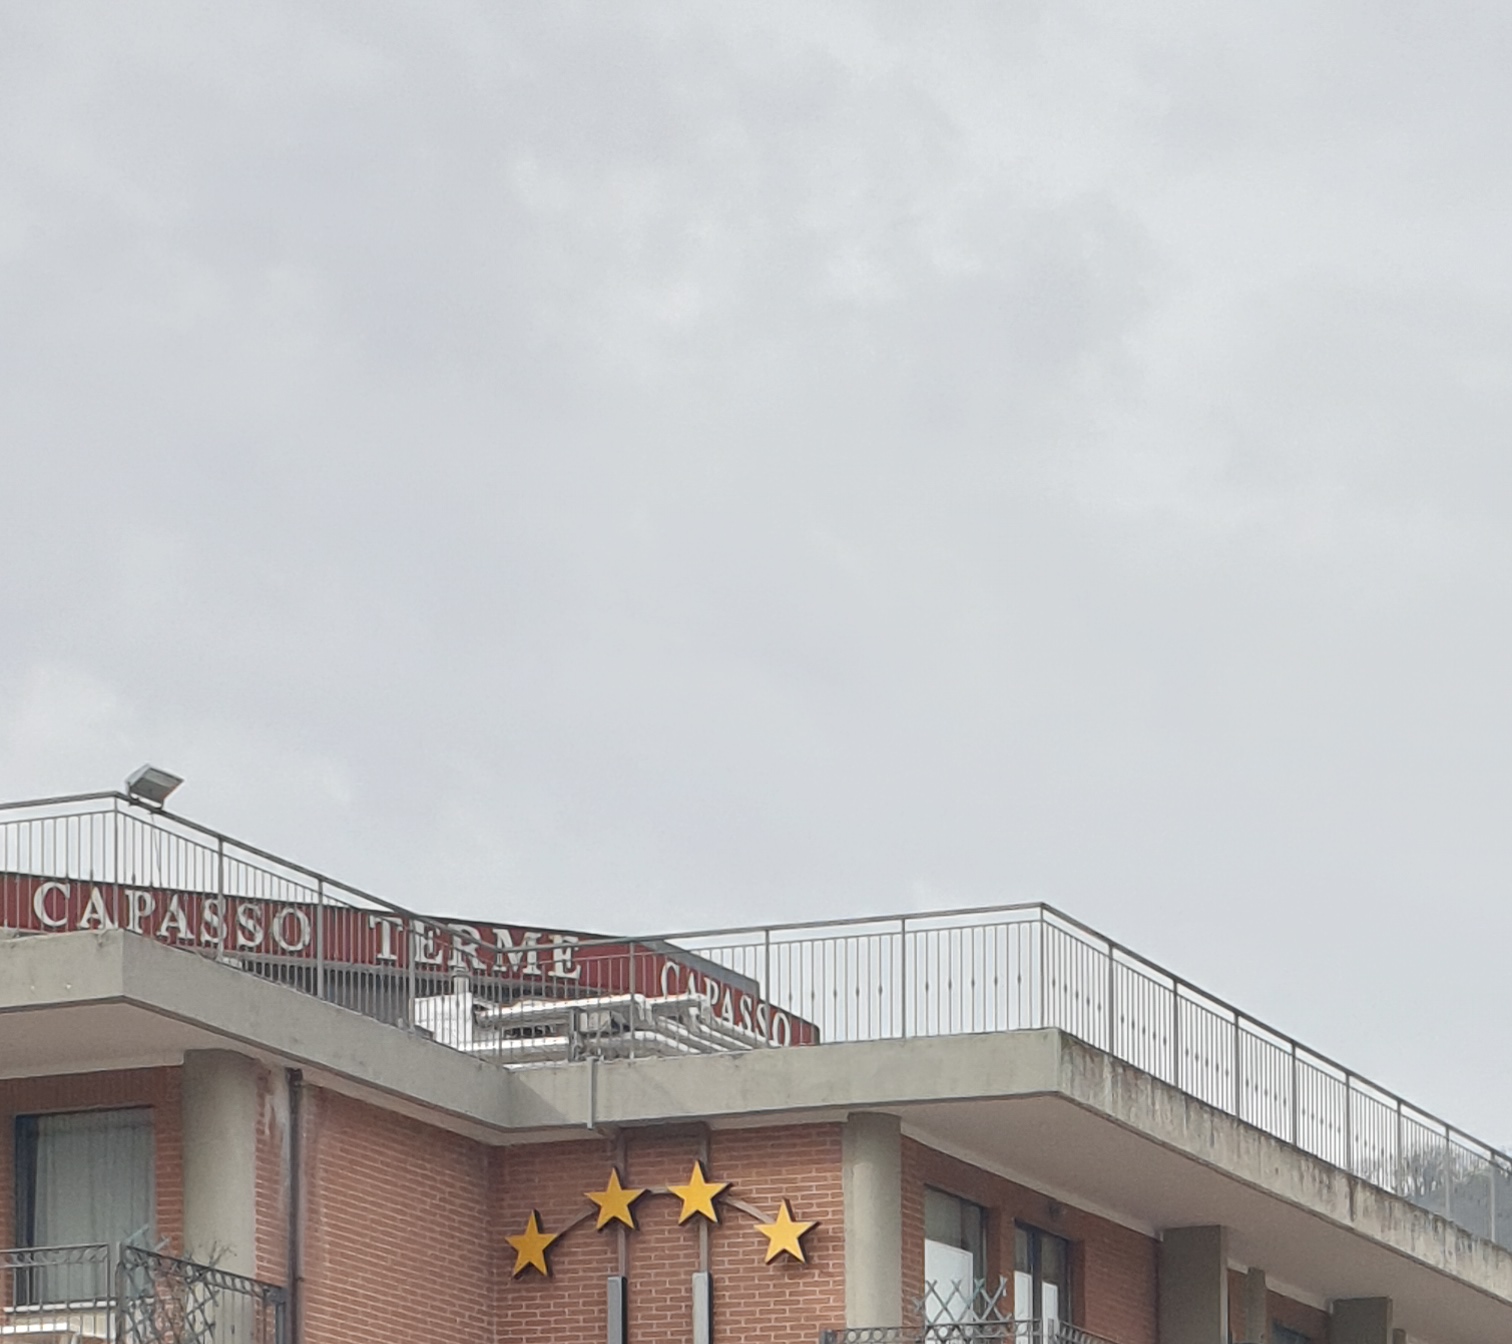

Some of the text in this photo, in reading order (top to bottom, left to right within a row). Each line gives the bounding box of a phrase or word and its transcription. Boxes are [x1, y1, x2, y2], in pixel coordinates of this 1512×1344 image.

[33, 881, 582, 980] CAPASSO TERME
[660, 961, 792, 1048] CAPASSO
